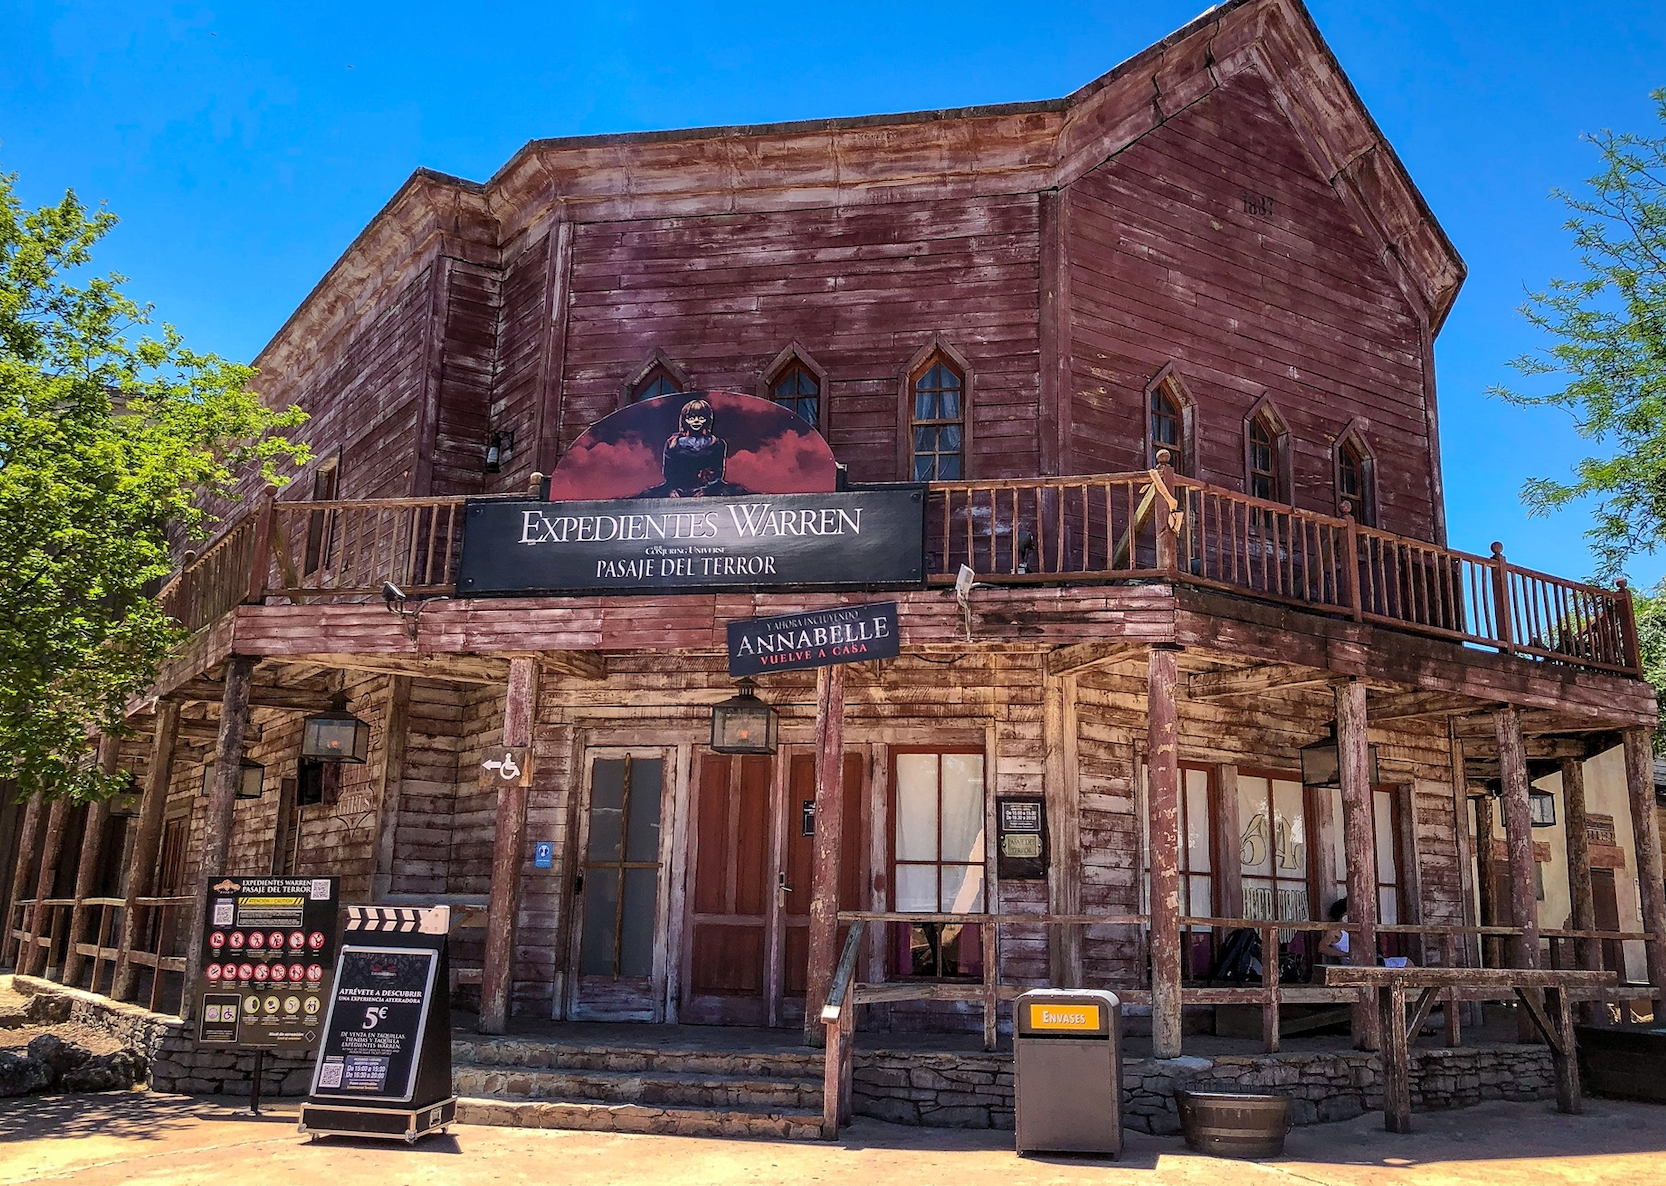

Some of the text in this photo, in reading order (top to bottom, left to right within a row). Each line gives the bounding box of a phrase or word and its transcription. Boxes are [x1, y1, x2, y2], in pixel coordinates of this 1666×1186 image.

[518, 503, 863, 543] EXPEDIENTES WARREN
[596, 556, 776, 580] PASAJE DEL TERROR
[767, 610, 860, 631] Y AHORA INCLUYENDO
[736, 616, 890, 657] ANNABELLE
[760, 643, 868, 665] VUELVE A CASA
[242, 886, 265, 894] PASAJE
[339, 987, 374, 996] ATRÉVETE
[381, 990, 422, 998] DESCUBRIR
[362, 1006, 389, 1029] 5€
[1043, 1010, 1087, 1024] ENVASES
